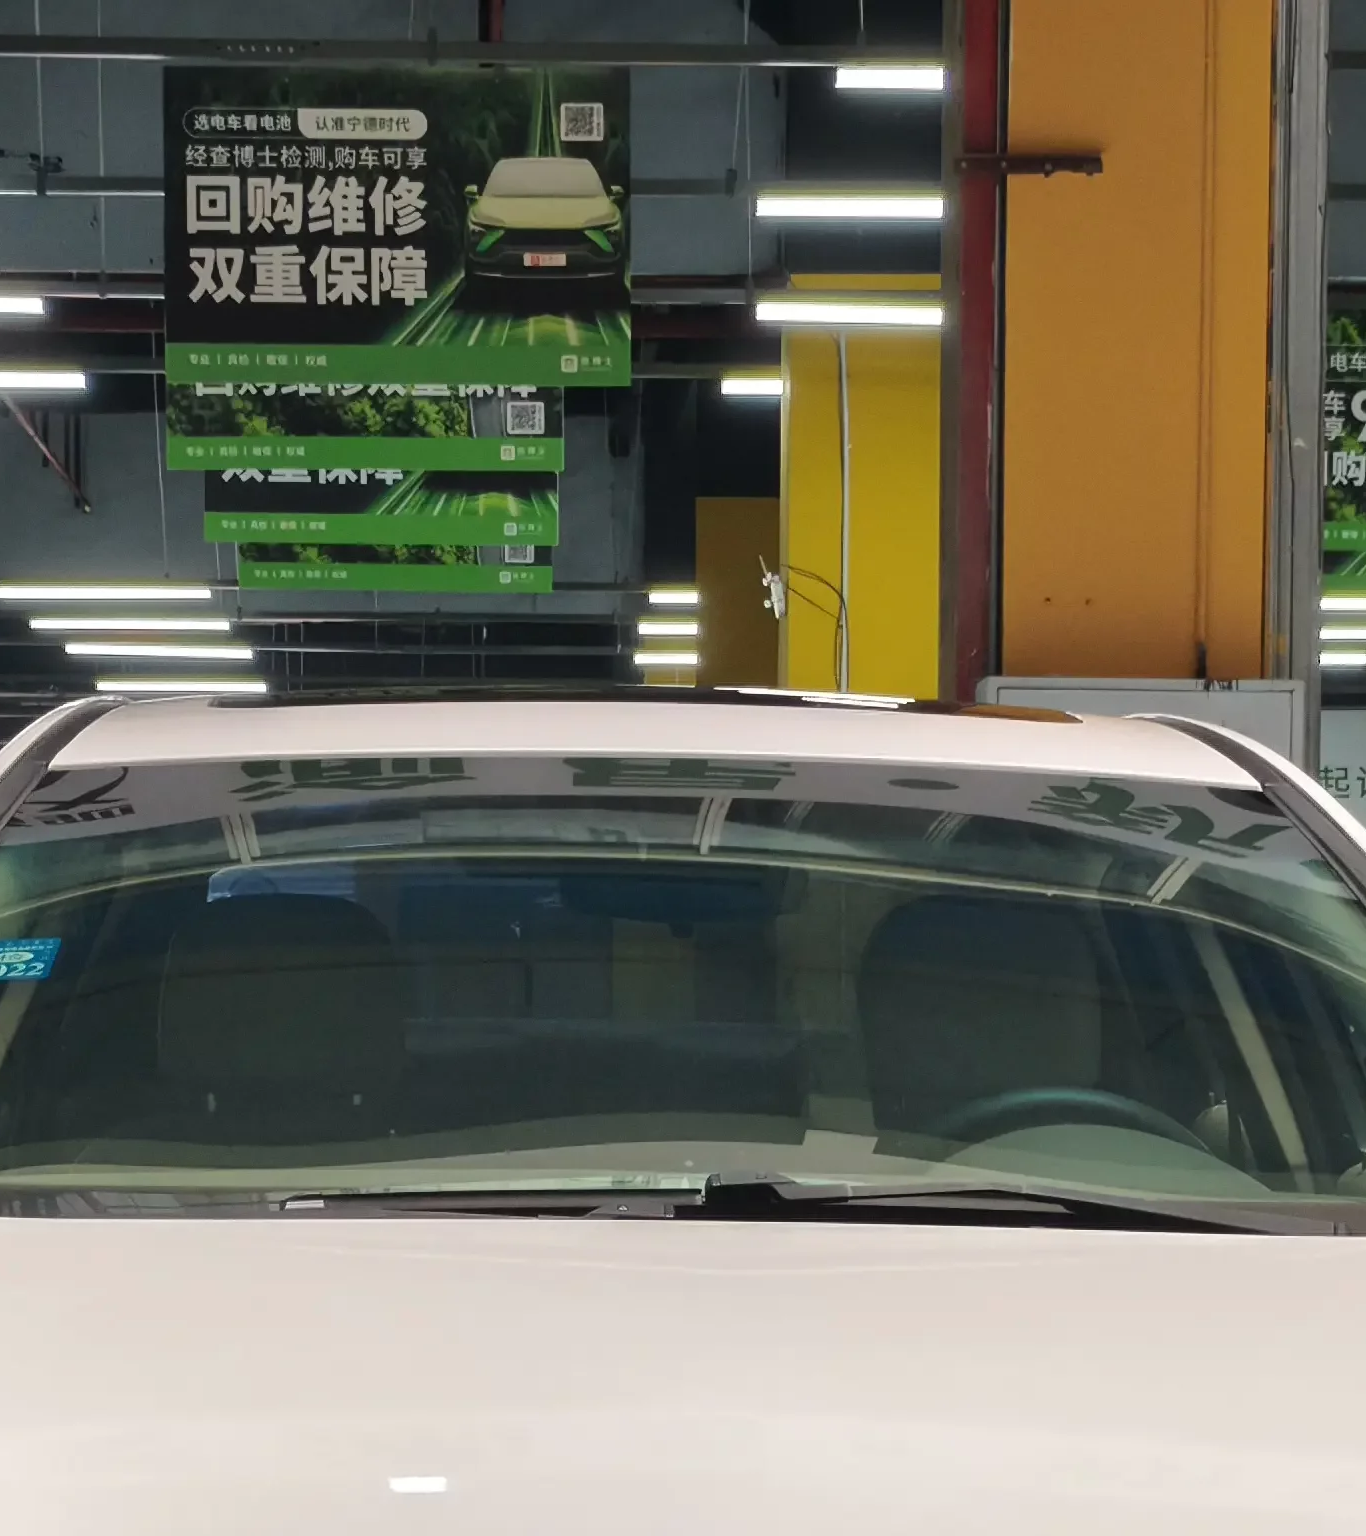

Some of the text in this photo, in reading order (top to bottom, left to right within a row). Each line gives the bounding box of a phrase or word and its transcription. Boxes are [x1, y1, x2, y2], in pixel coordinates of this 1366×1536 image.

[194, 114, 411, 132] 选电车看电池 认准宁德时代
[185, 145, 428, 170] 经查博士检测,购车可享
[185, 175, 428, 236] 回购维修
[188, 245, 428, 306] 双重保障
